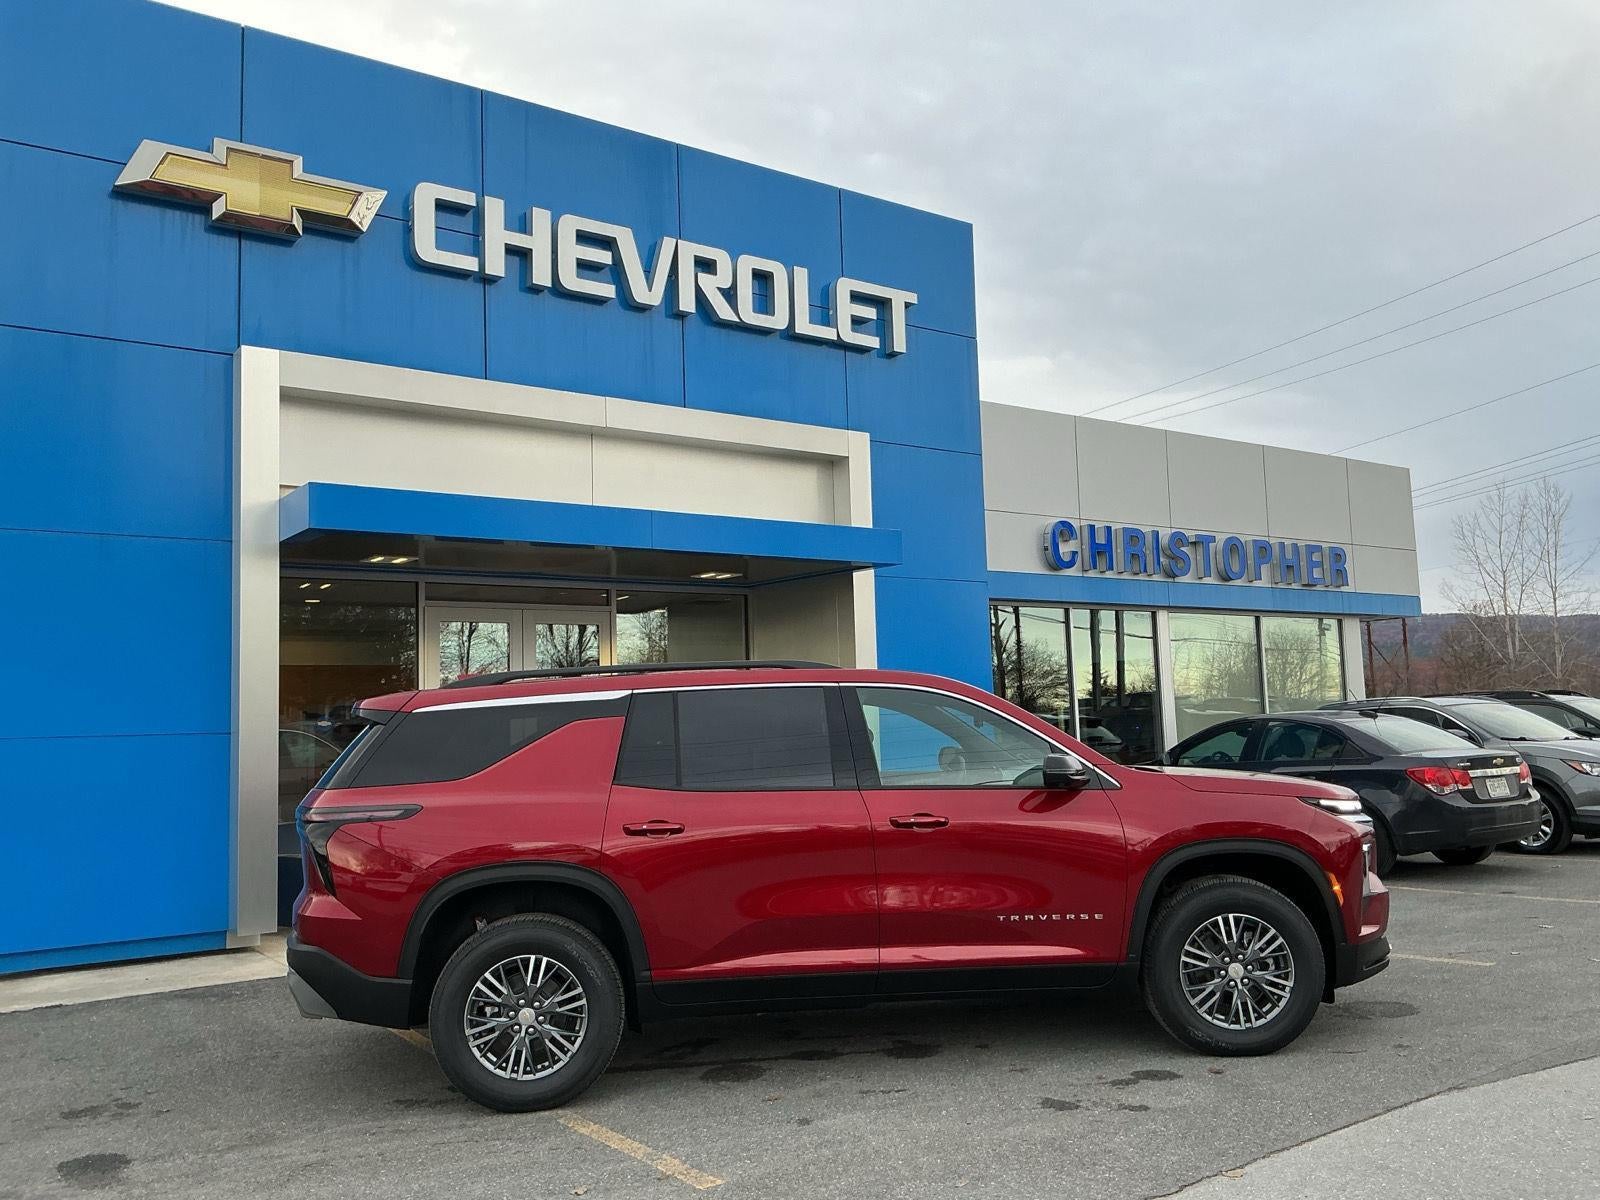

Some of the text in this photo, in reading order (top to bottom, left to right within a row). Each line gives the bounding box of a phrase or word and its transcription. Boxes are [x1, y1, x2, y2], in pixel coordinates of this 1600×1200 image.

[410, 182, 918, 356] CHEVROLET
[1045, 519, 1350, 588] CHRISTOPHER
[997, 913, 1104, 921] TRAVERSE
